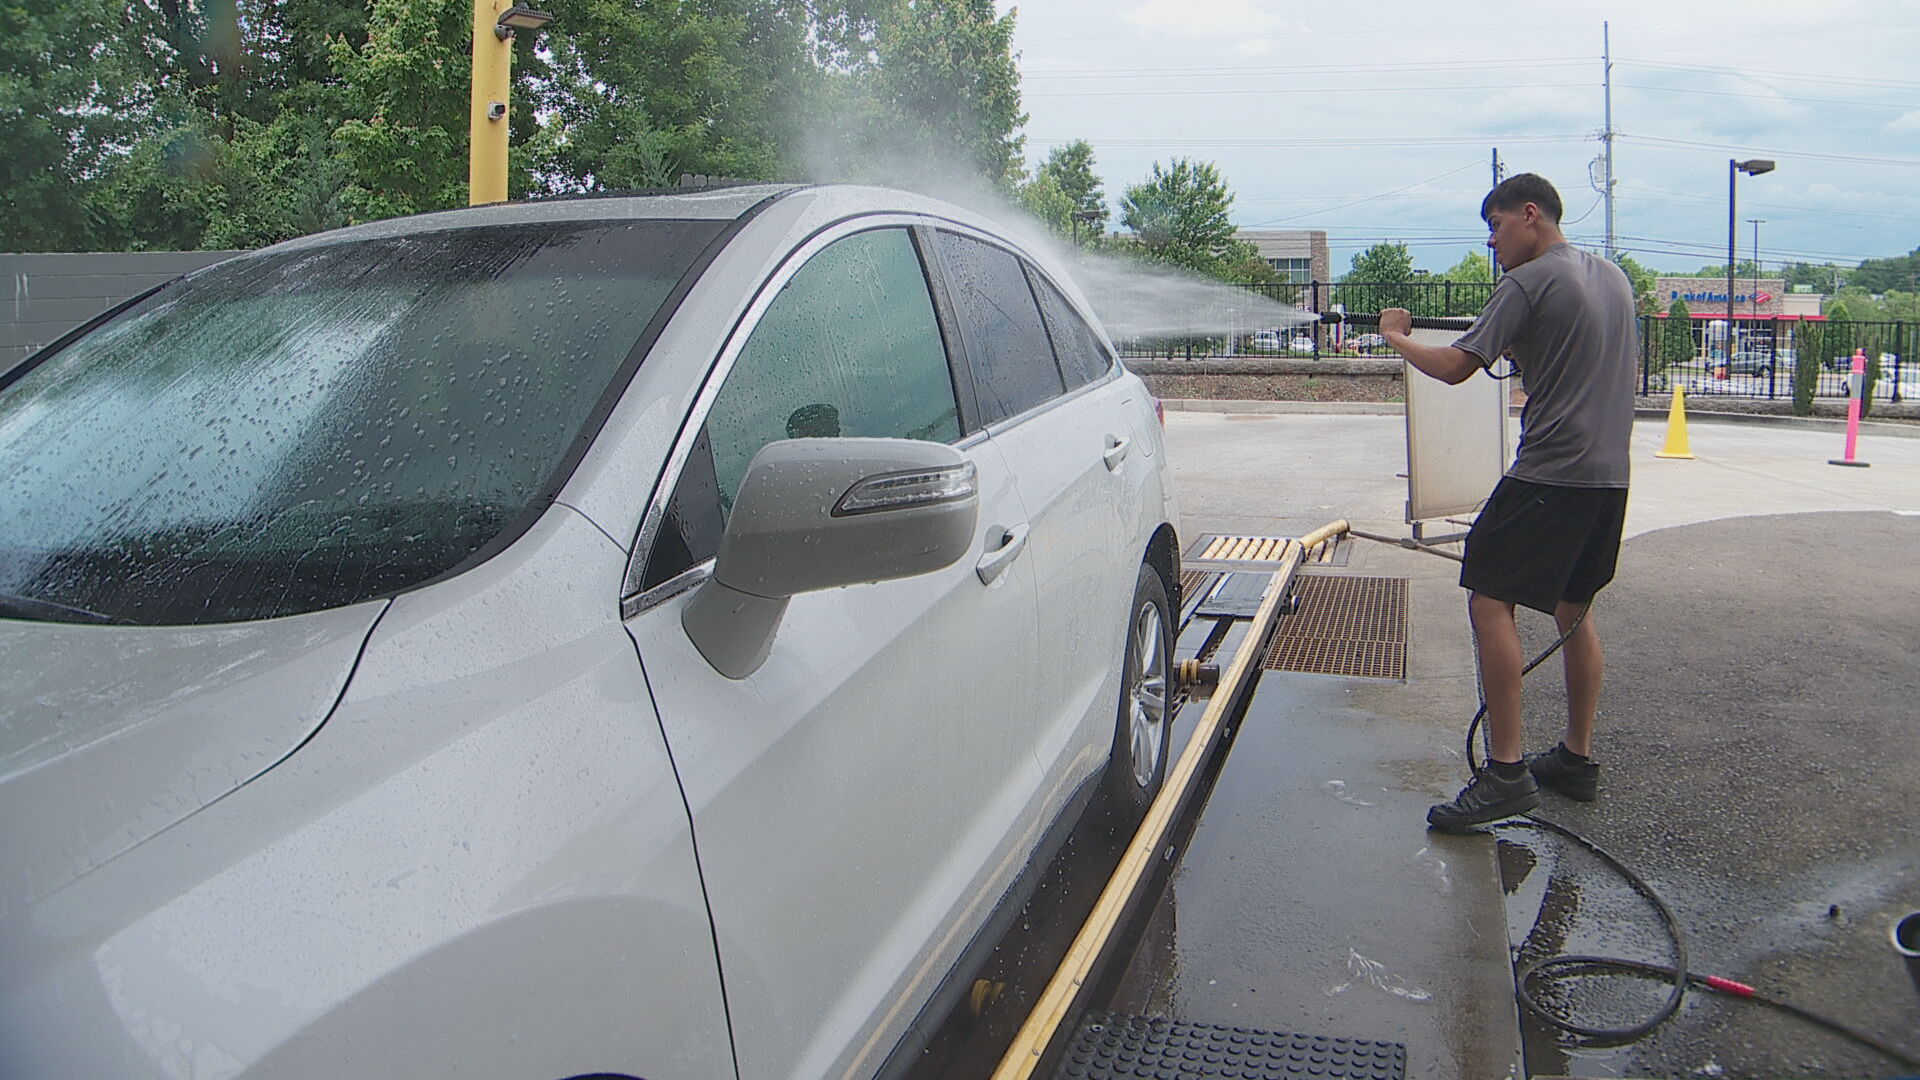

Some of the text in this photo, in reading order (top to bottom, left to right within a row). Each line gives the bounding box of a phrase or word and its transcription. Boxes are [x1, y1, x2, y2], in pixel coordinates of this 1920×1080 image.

[1671, 290, 1746, 303] Bnk of Ameca
